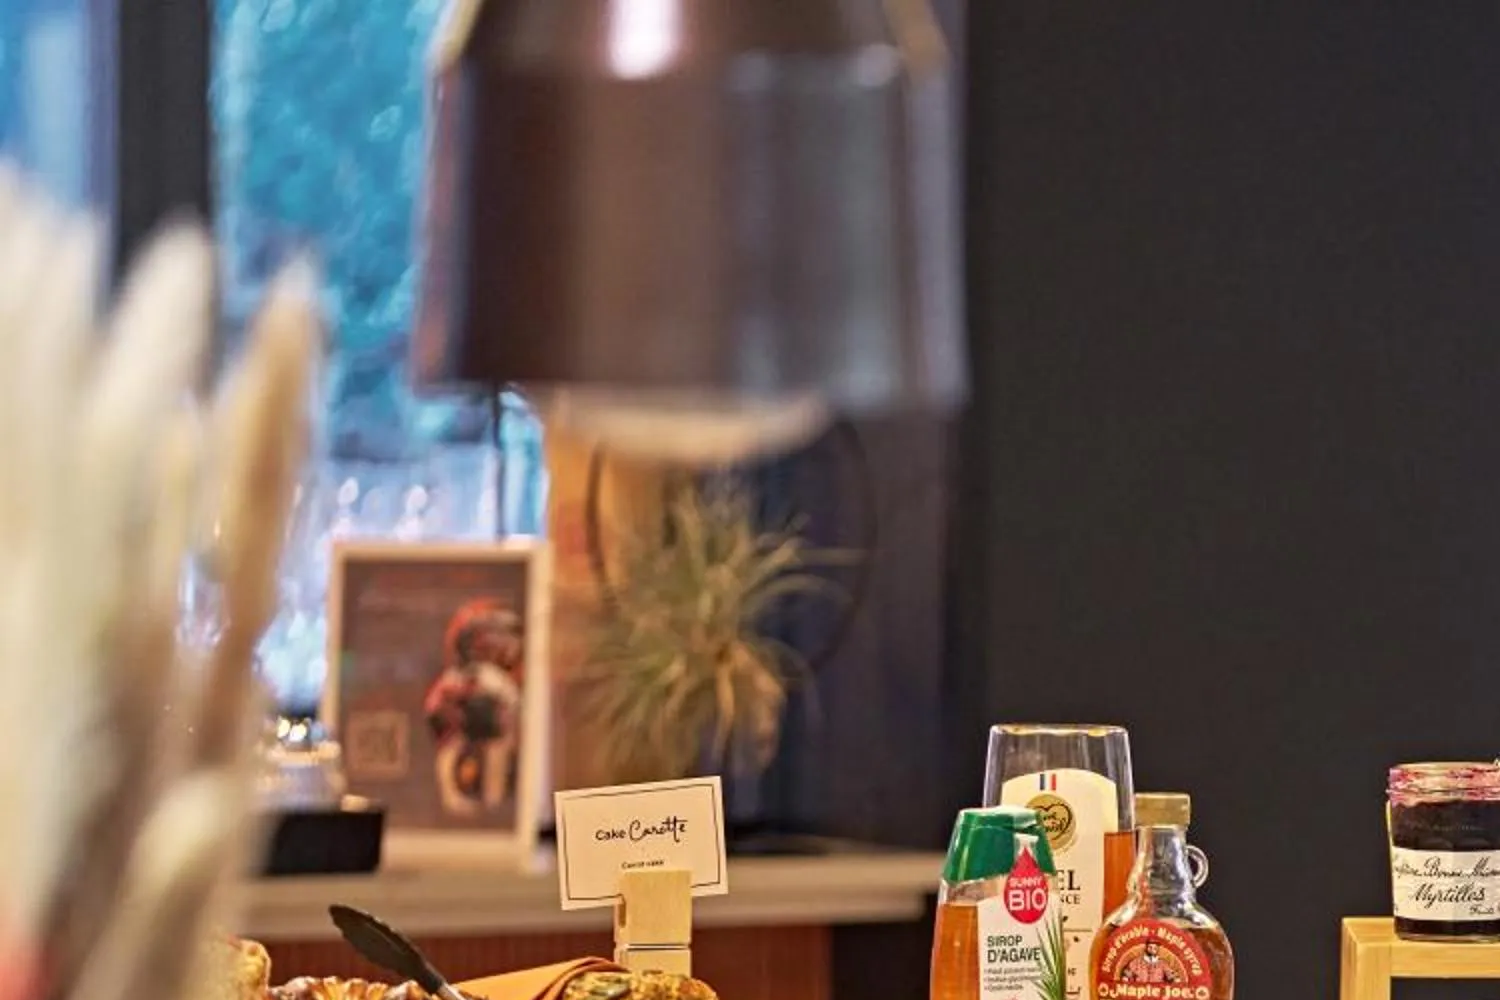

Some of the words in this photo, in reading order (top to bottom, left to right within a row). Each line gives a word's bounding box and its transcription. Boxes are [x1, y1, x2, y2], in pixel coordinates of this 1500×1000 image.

[629, 815, 689, 844] Carotte
[1009, 888, 1047, 911] BIO
[1414, 882, 1486, 909] Myrtilles
[987, 935, 1023, 948] SIROP
[987, 948, 1041, 963] D'AGAVE
[1109, 983, 1161, 999] Maple
